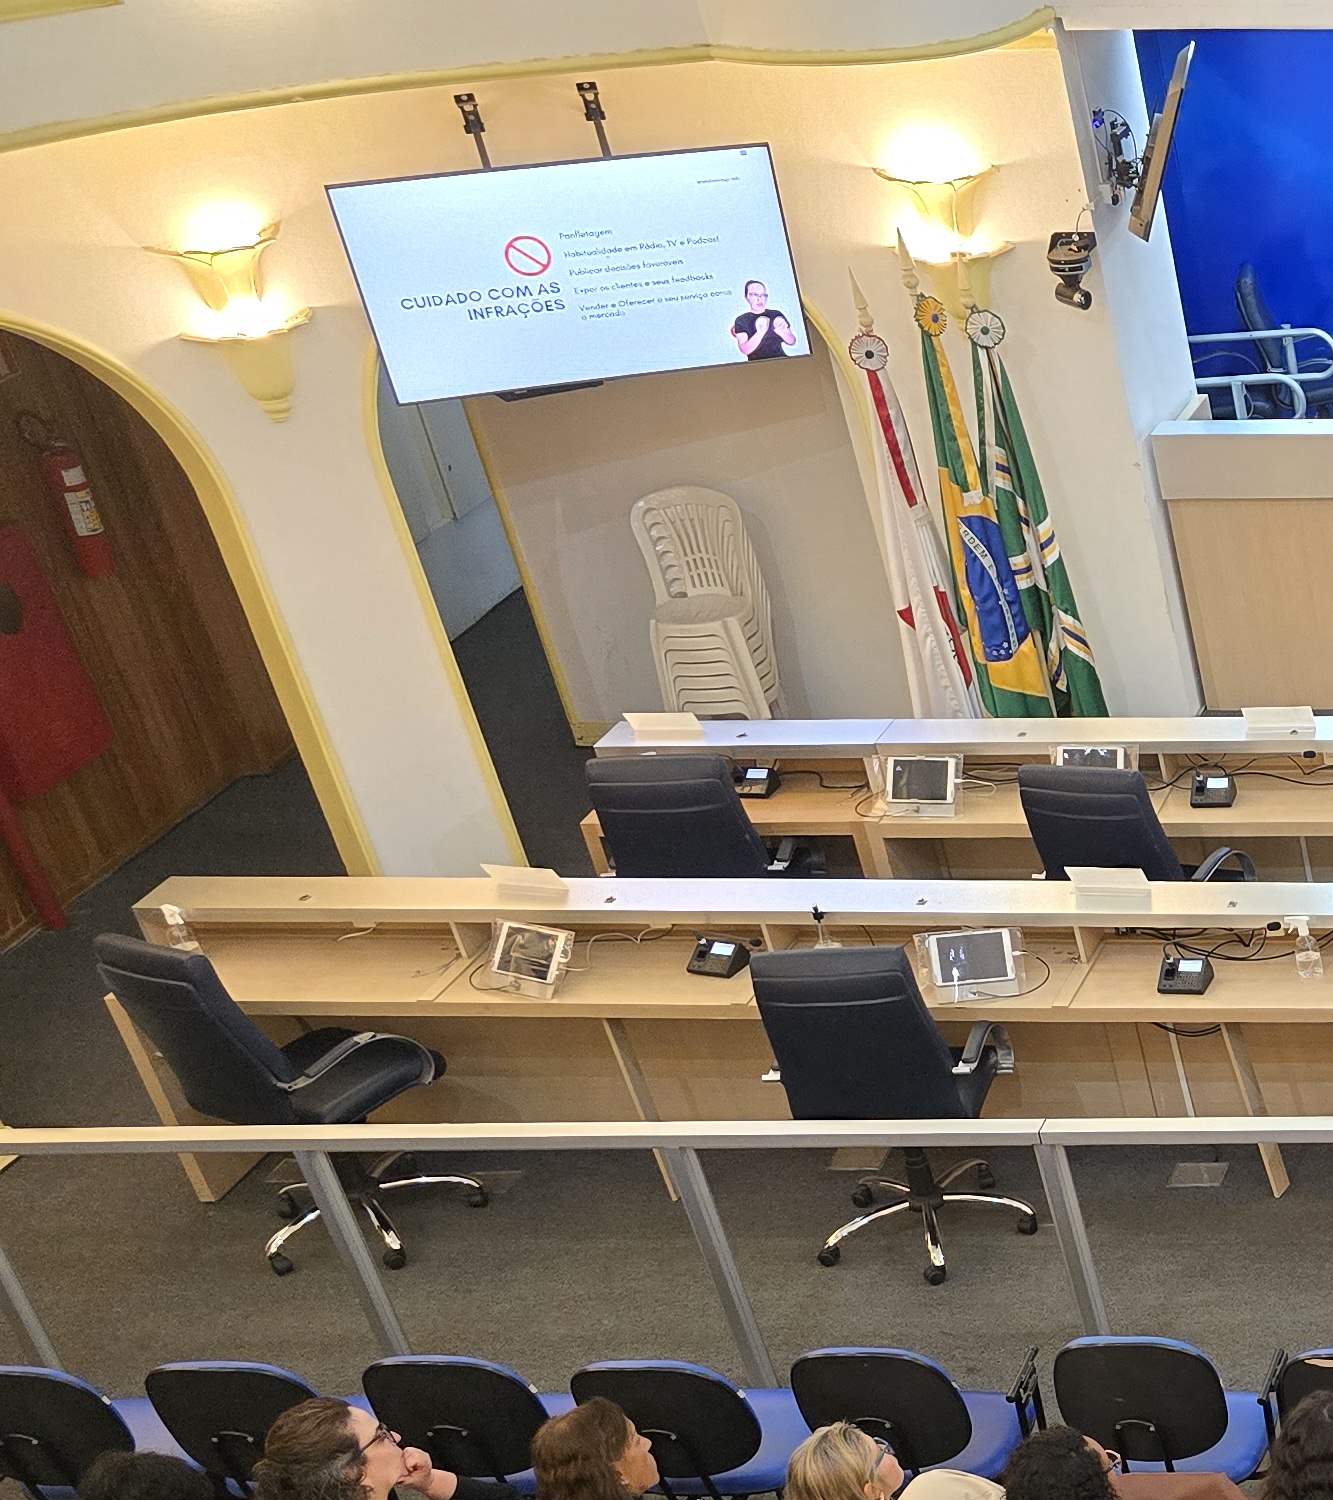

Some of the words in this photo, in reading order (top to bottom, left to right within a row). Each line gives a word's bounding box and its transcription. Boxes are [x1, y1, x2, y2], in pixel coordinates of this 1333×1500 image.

[687, 236, 720, 245] Podcast
[612, 281, 642, 290] clientes
[401, 291, 481, 310] CUIDADO
[488, 285, 533, 300] COM
[538, 282, 561, 295] AS
[467, 299, 565, 320] INFRAÇÕES
[579, 302, 609, 312] Vender
